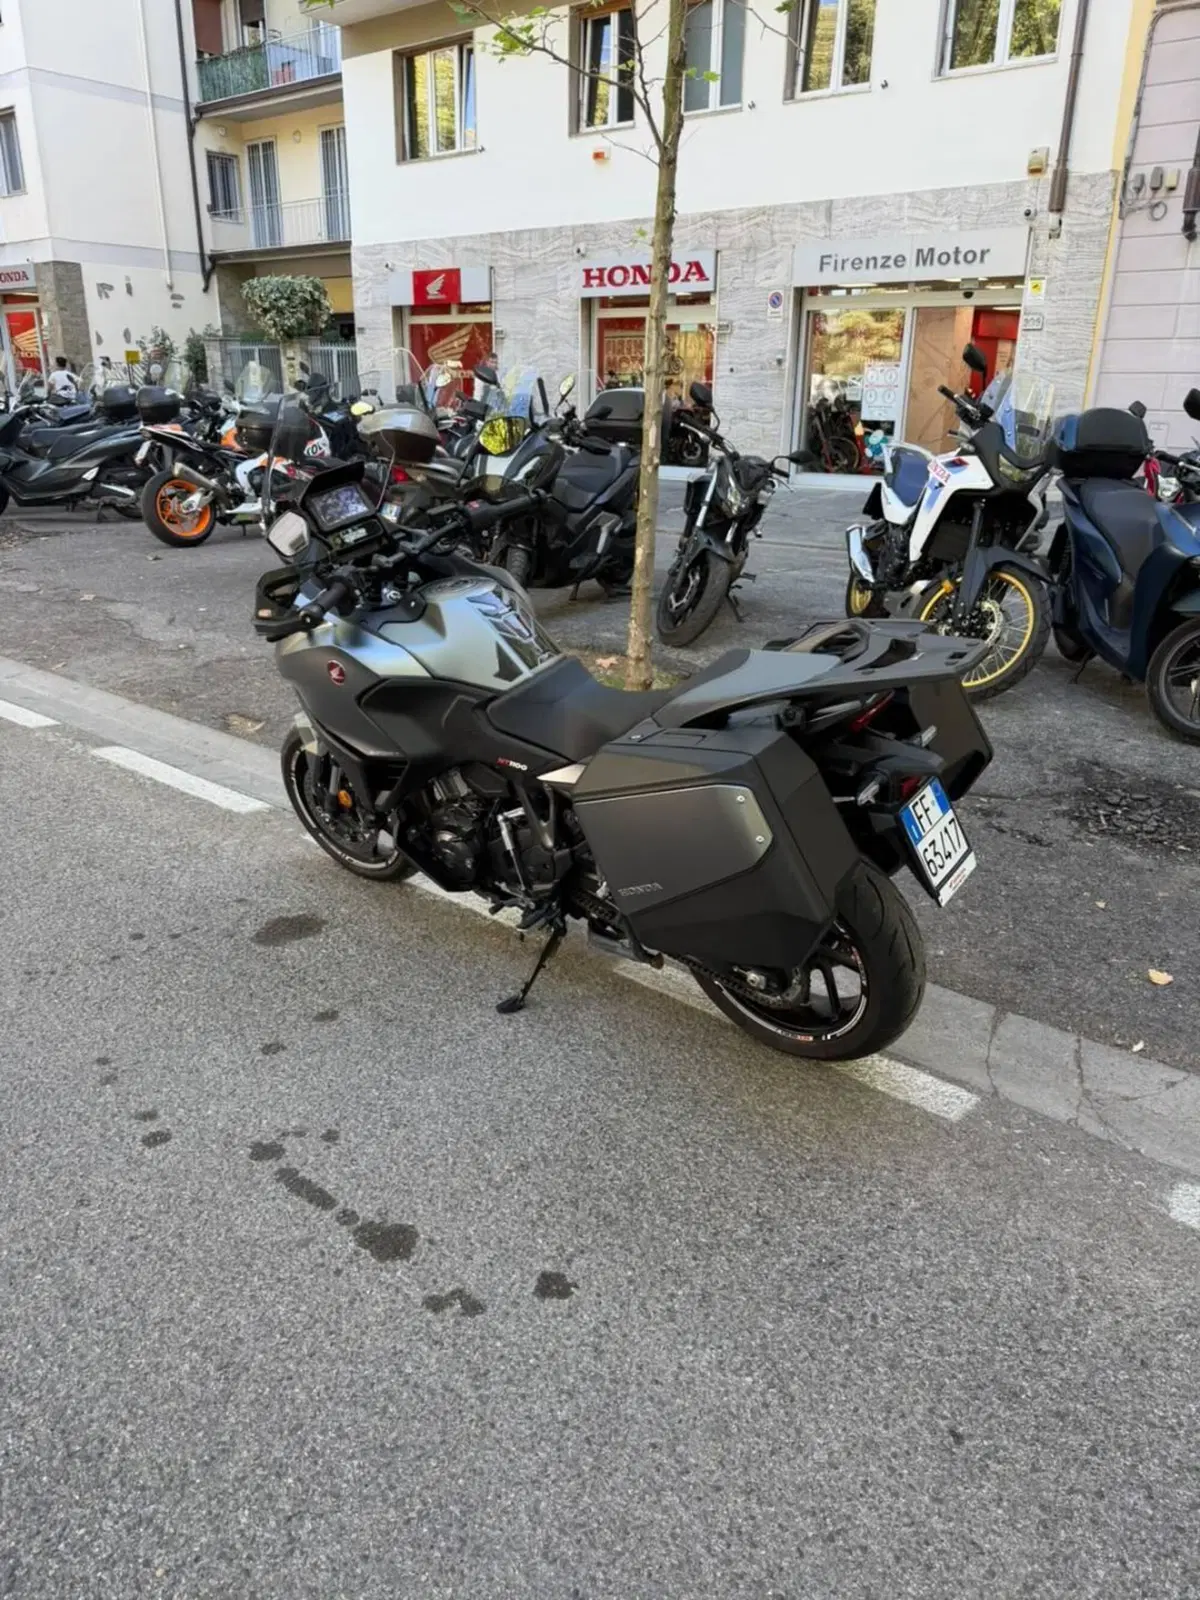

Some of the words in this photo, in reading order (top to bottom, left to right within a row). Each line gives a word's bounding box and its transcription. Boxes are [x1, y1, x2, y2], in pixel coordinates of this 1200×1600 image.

[819, 253, 906, 273] Firenze
[915, 246, 991, 268] Motor
[0, 270, 29, 283] ONDA
[911, 793, 933, 833] FF
[922, 817, 962, 877] 63417
